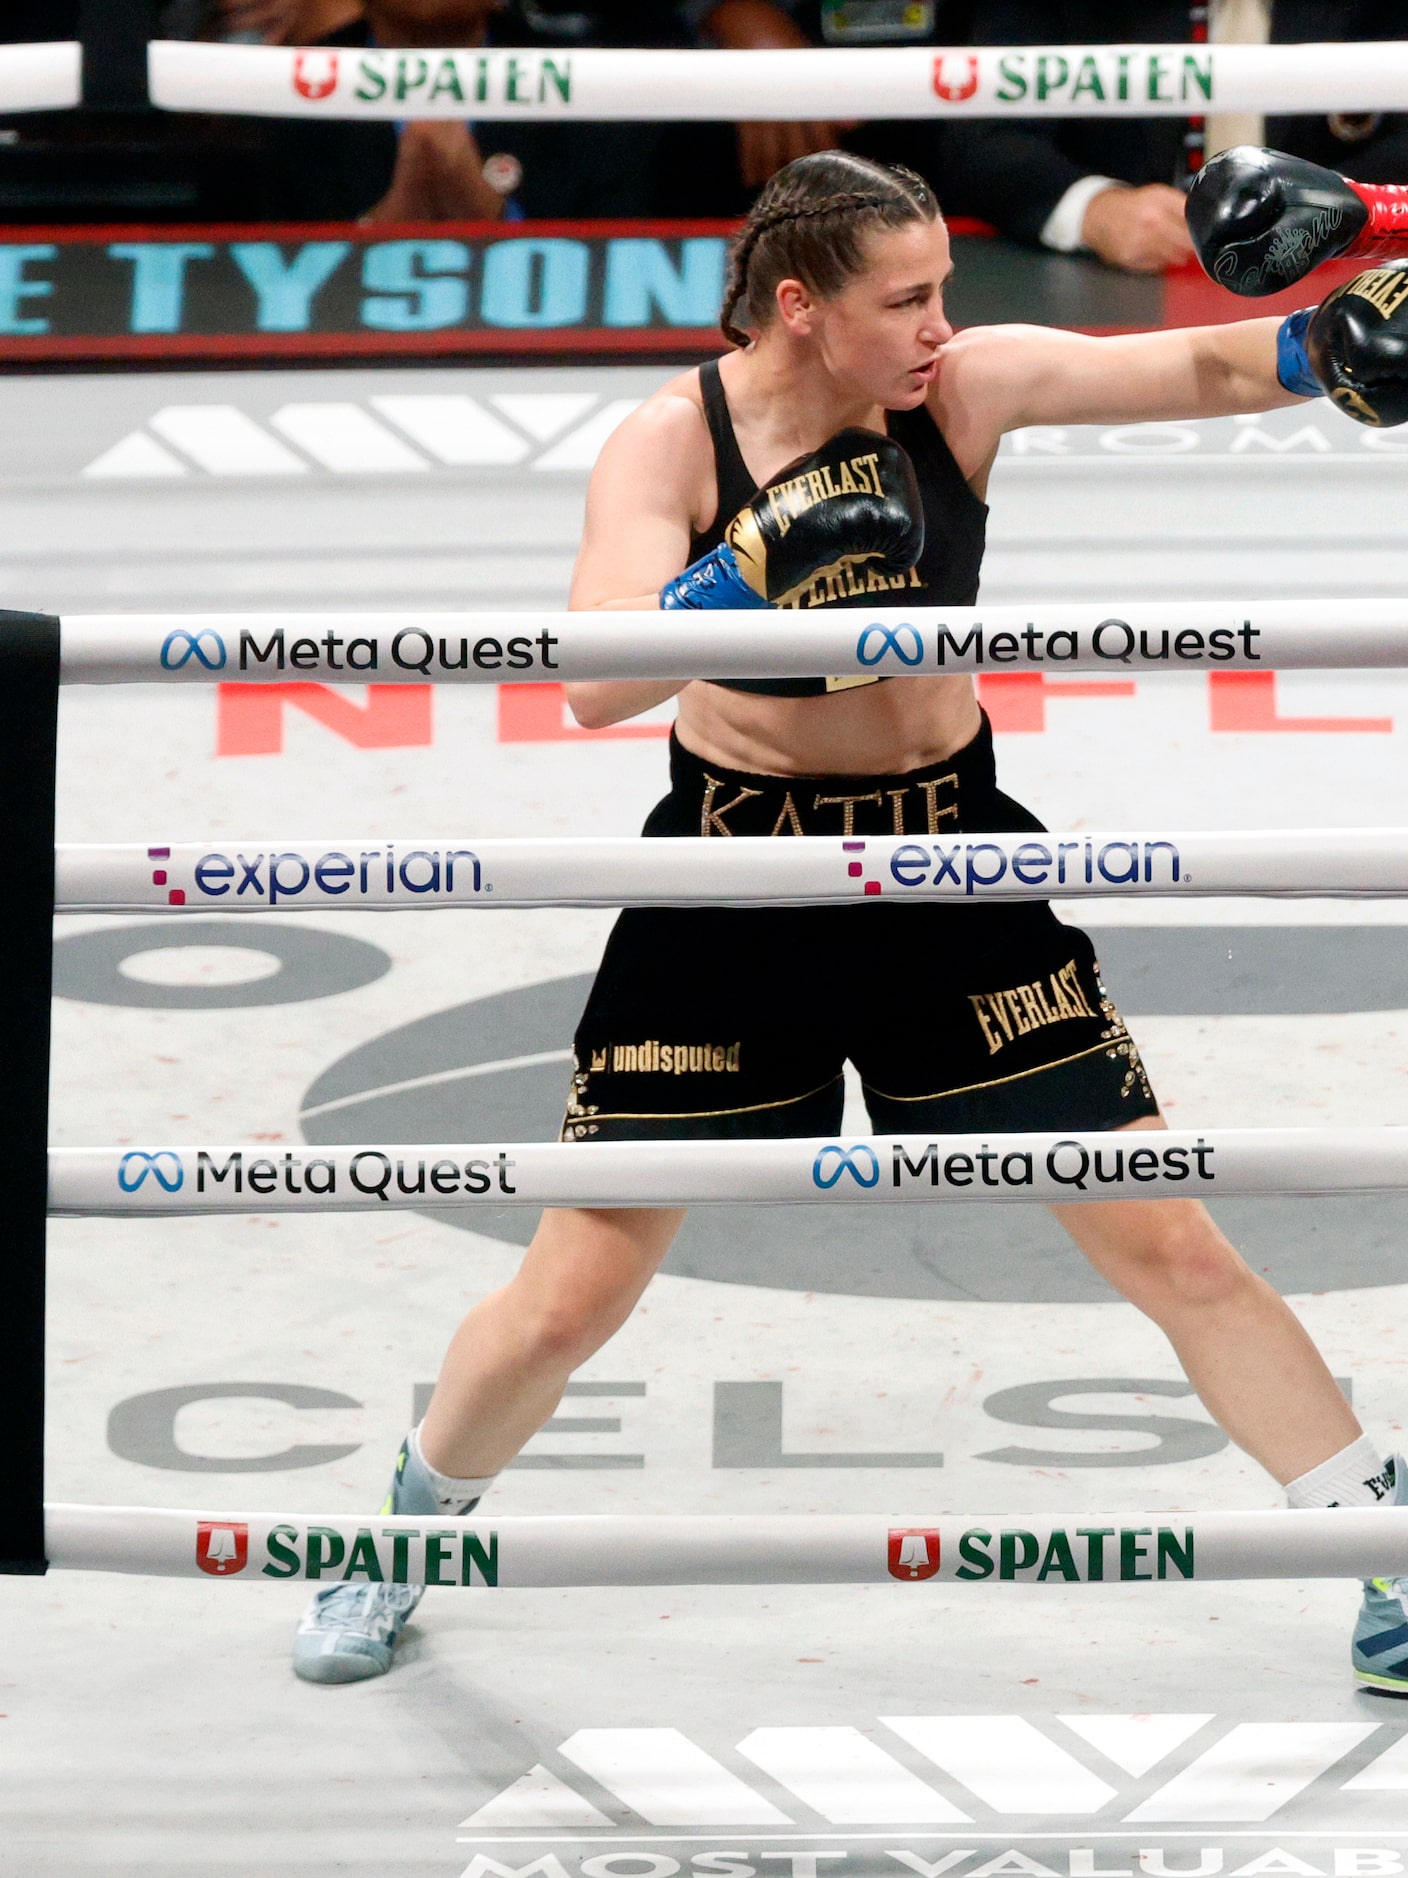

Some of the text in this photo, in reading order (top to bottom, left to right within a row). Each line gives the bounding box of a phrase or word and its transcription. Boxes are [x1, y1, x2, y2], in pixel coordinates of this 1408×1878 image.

[355, 51, 571, 104] SPATEN
[995, 53, 1214, 102] SPATEN
[107, 238, 728, 333] TYSON
[766, 453, 886, 538] EVERLAST
[238, 626, 559, 676] Meta Quest
[936, 618, 1262, 666] Meta Quest
[194, 843, 481, 904] experian
[890, 835, 1180, 896] experian
[967, 958, 1099, 1057] EVERLAST
[613, 1040, 741, 1075] undisputed
[196, 1150, 516, 1202] Meta Quest
[892, 1137, 1215, 1191] Meta Quest
[262, 1523, 499, 1588] SPATEN
[955, 1524, 1196, 1582] SPATEN
